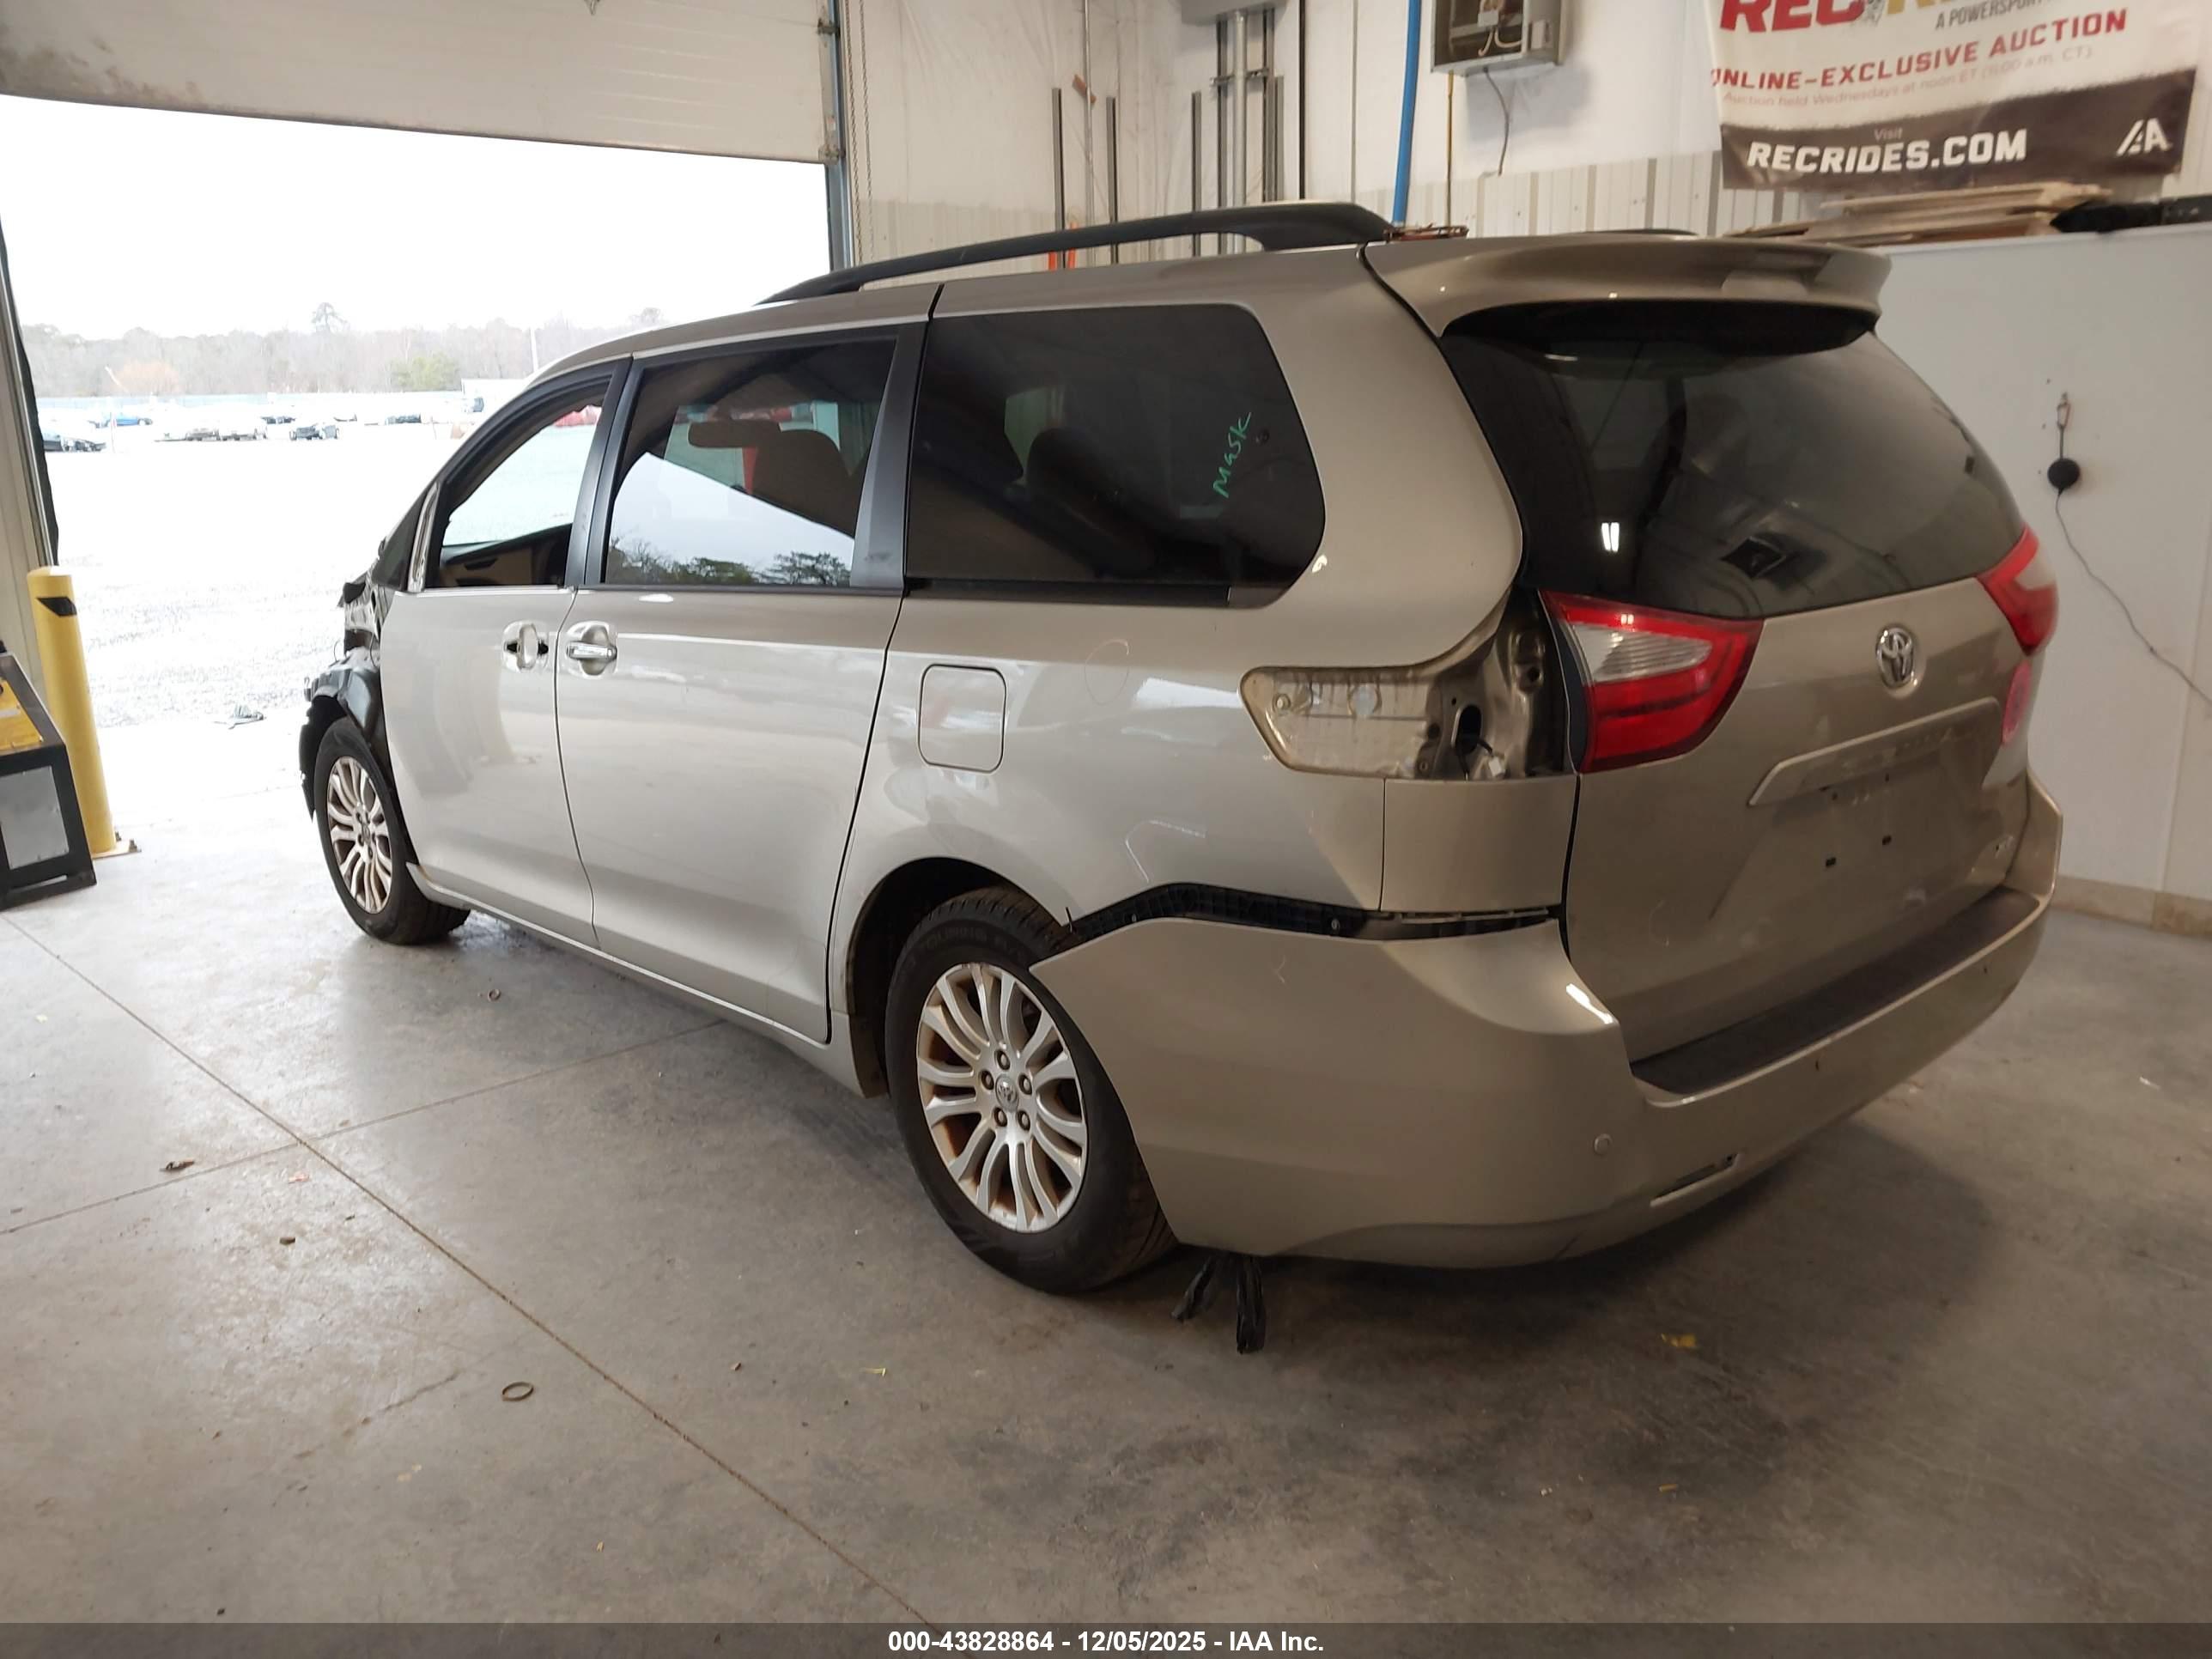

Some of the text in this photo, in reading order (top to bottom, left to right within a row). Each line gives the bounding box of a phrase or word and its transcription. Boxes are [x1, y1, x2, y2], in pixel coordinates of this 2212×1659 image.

[1989, 8, 2127, 58] AUCTION
[1747, 129, 2027, 173] RECRIDES.COM
[1875, 127, 1903, 141] Visit
